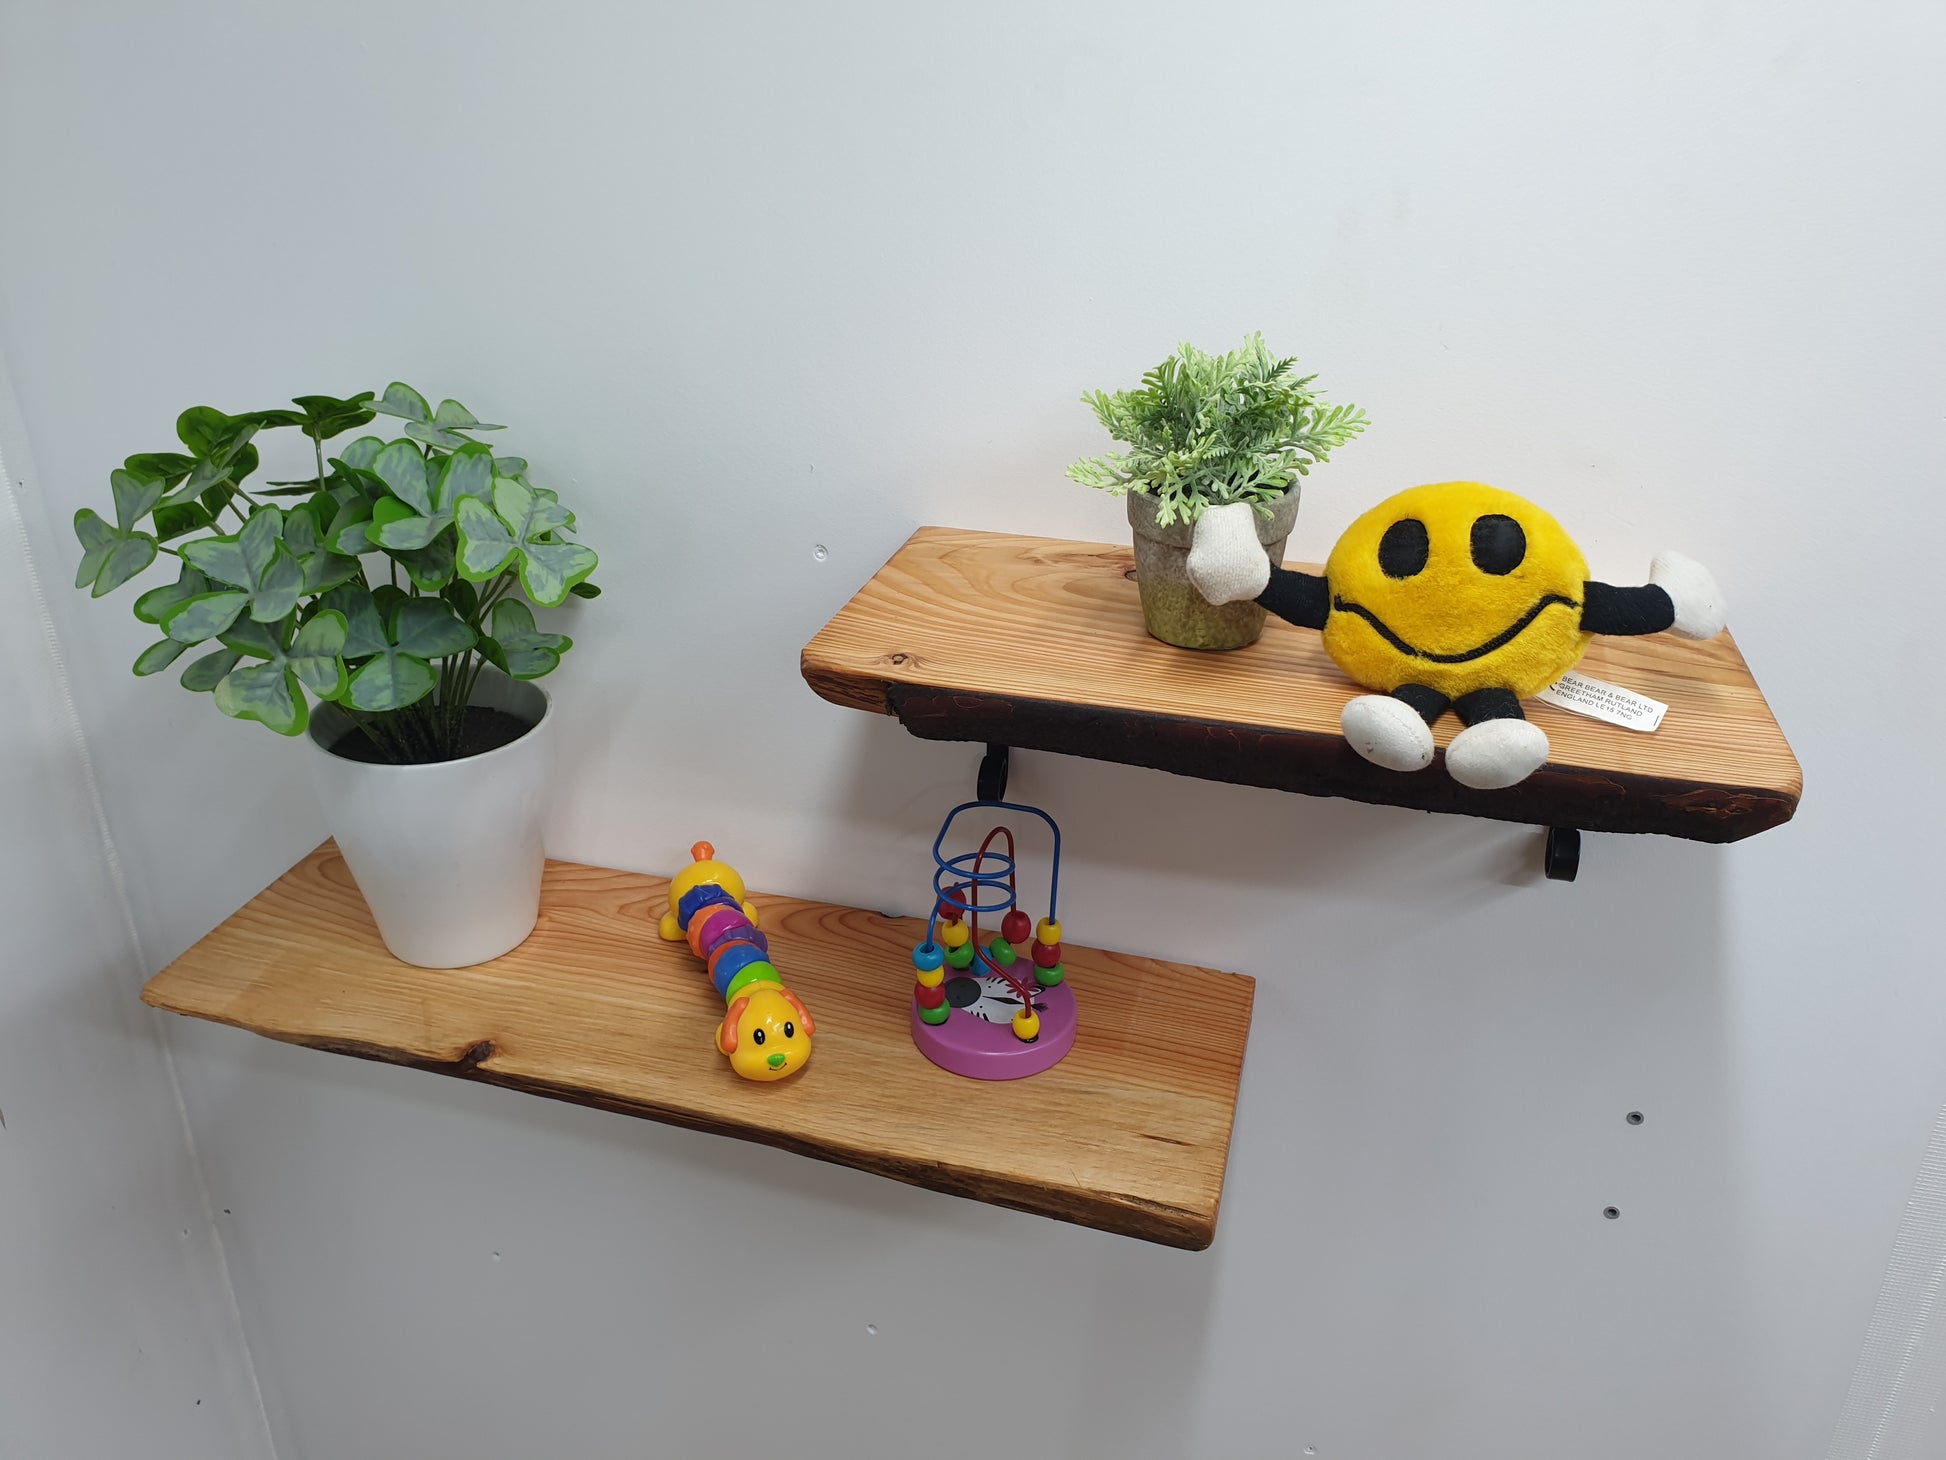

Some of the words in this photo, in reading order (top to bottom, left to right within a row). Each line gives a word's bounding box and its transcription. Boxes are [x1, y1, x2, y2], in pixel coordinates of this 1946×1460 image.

[1556, 689, 1594, 706] ENGLAND
[1595, 701, 1614, 713] LE15
[1616, 710, 1632, 720] 7NG
[1558, 683, 1604, 702] GREETHAM
[1605, 698, 1643, 717] RUTLAND
[1562, 676, 1583, 688] BEAR
[1584, 684, 1606, 696] BEAR
[1615, 694, 1637, 706] BEAR
[1638, 703, 1653, 713] LTD
